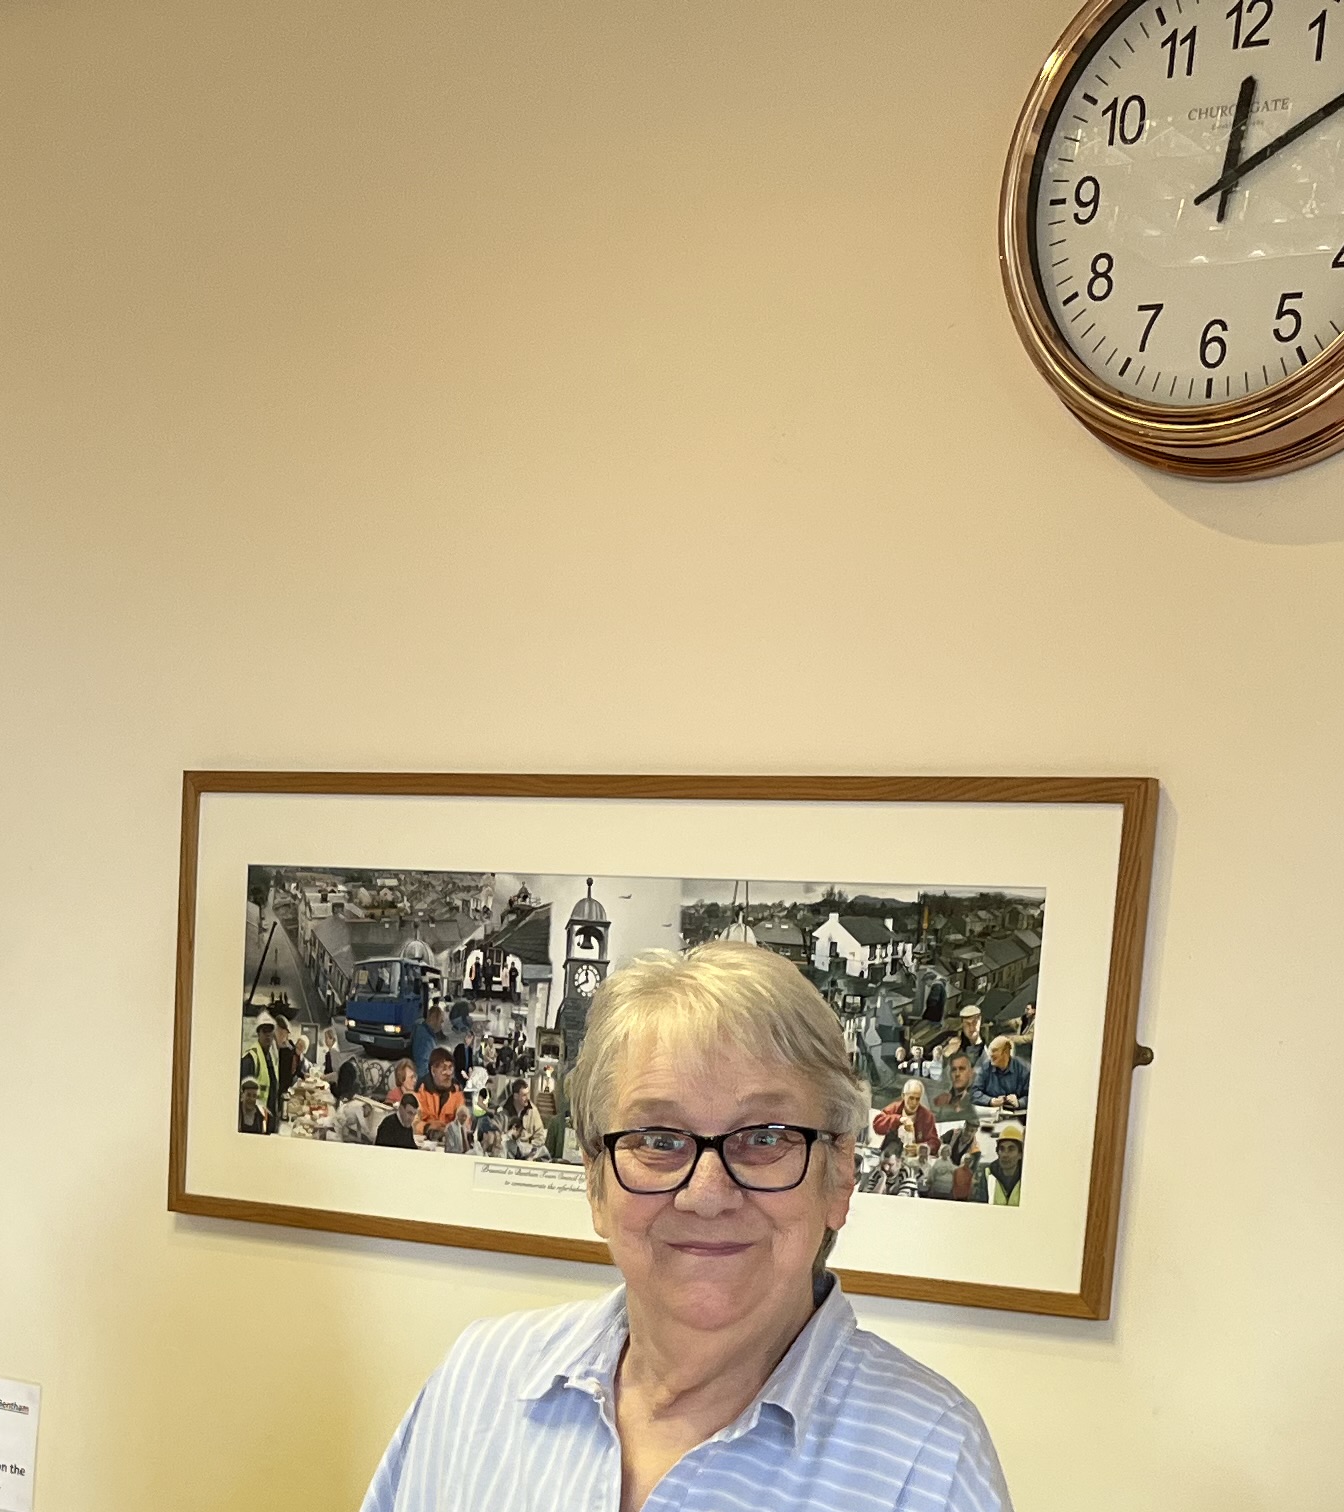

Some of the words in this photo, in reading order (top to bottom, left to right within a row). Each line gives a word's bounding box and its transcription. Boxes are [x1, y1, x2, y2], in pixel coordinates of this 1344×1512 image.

[1226, 0, 1275, 48] 12
[1308, 10, 1328, 61] 1
[1161, 26, 1198, 79] 11
[1102, 95, 1146, 146] 10
[1188, 98, 1290, 120] CHURCGATE
[1073, 176, 1100, 224] 9
[1087, 253, 1114, 301] 8
[1136, 303, 1163, 352] 7
[1273, 292, 1303, 342] 5
[1199, 319, 1228, 368] 6
[10, 1464, 26, 1476] the
